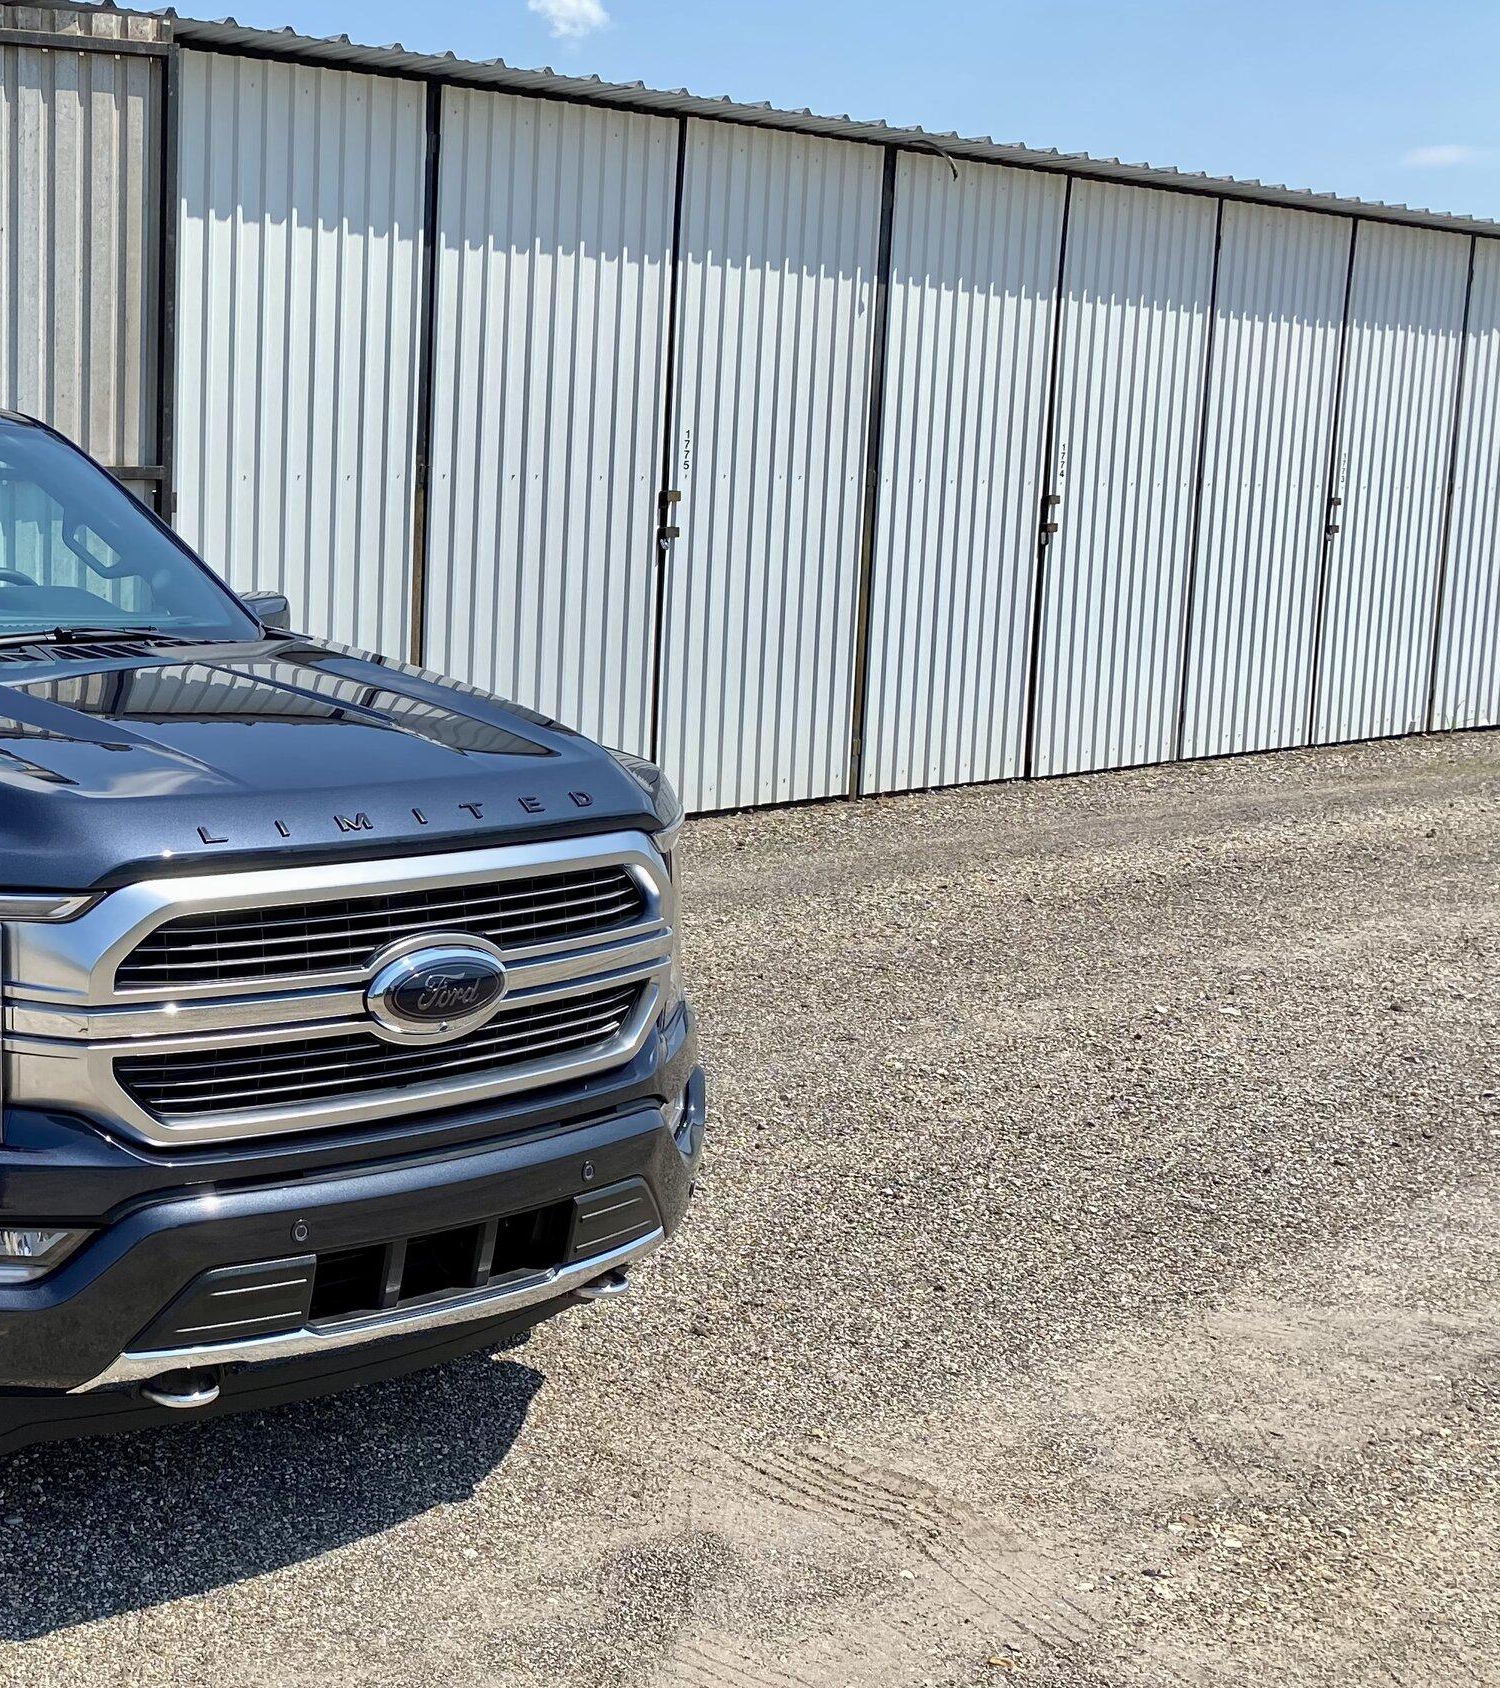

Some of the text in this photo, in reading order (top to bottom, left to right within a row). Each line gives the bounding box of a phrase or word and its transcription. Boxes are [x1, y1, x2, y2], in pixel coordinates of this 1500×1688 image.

[683, 429, 691, 470] 1775
[197, 790, 596, 845] LIMITED
[417, 972, 481, 1011] Ford
